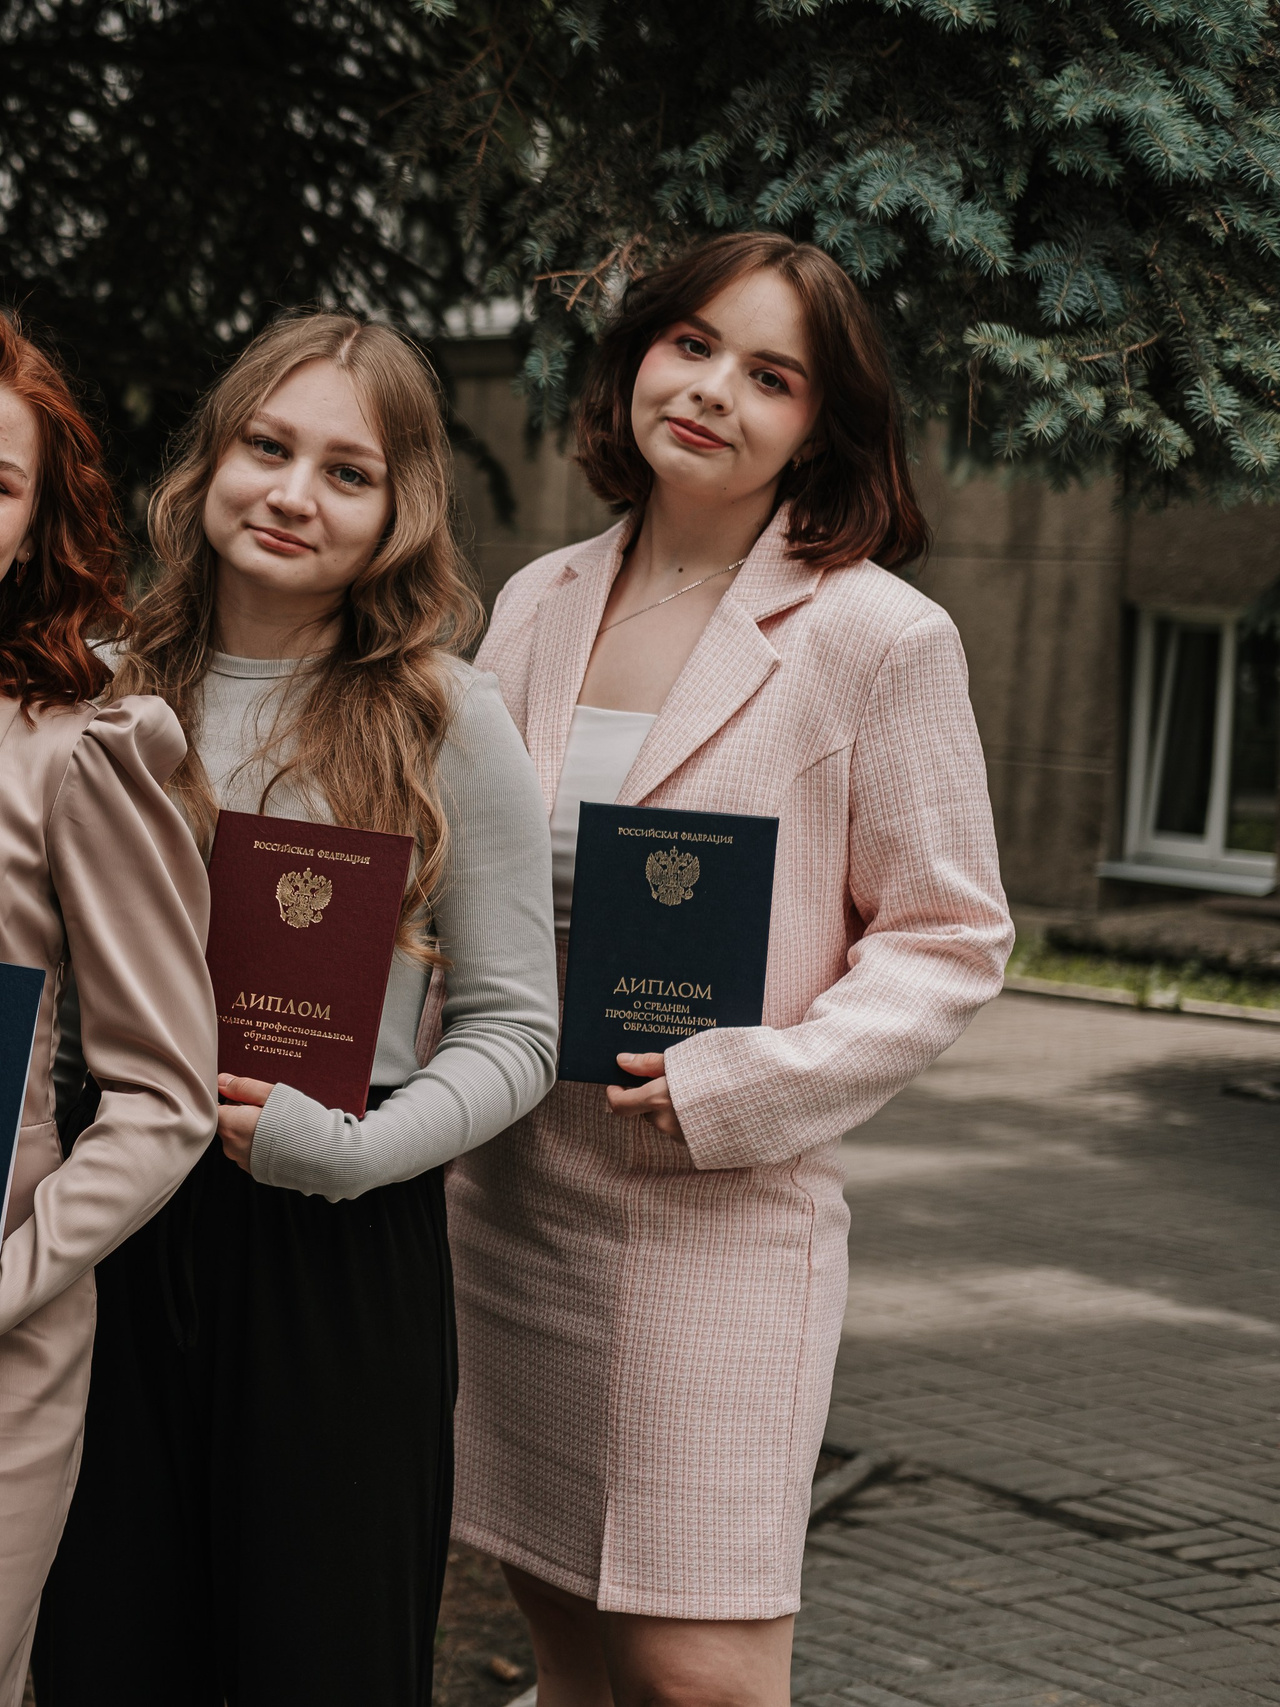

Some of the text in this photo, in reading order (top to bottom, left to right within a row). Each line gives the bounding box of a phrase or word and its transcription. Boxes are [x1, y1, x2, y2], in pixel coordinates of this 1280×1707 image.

[617, 827, 734, 845] РОССИЙСКАЯ ФЕДЕРАЦИЯ
[253, 840, 371, 865] РОССИЙСКАЯ ФЕДЕРАЦИЯ
[613, 976, 712, 1000] ДИПЛОМ
[231, 991, 331, 1021] ДИПЛОМ
[643, 1001, 690, 1014] СРЕДНЕМ
[605, 1008, 717, 1028] ПРОФЕССИОНАЛЬНОМ
[243, 1029, 308, 1048] образовании
[255, 1020, 354, 1043] профессиональном
[623, 1021, 697, 1037] ОБРАЗОВАНИИ
[252, 1044, 302, 1059] отличием
